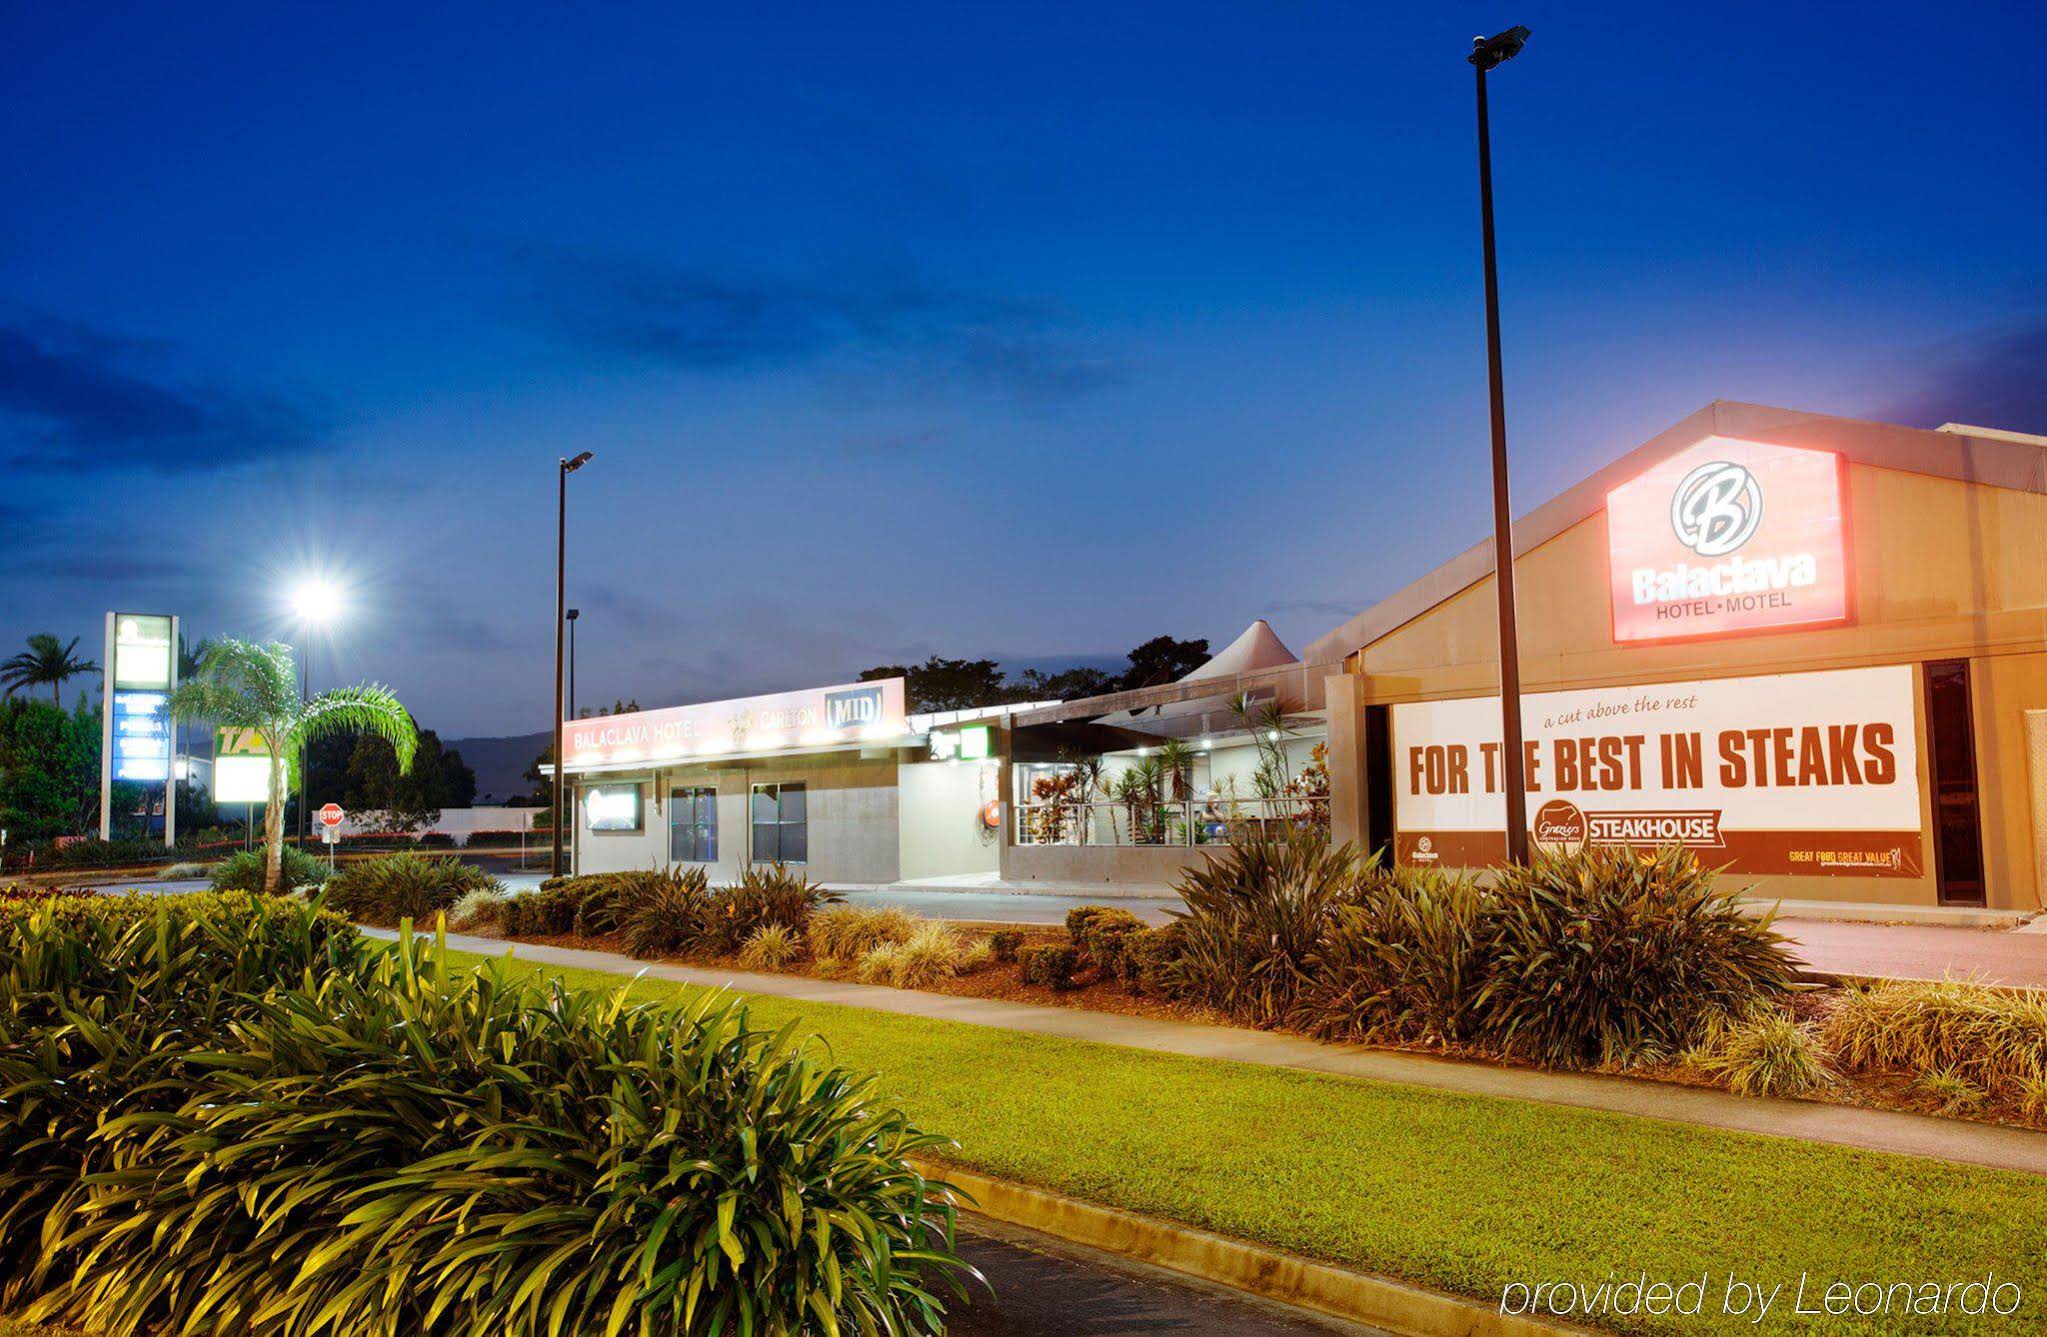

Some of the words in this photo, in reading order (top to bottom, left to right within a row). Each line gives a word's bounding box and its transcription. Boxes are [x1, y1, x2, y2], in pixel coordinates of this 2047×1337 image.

[1632, 553, 1816, 605] Balaclava
[834, 697, 874, 724] MID
[1544, 717, 1554, 728] a
[1558, 708, 1581, 725] cut
[1587, 702, 1631, 720] above
[1634, 696, 1661, 713] the
[1666, 695, 1699, 710] rest
[573, 724, 649, 750] BALACLAVA
[654, 719, 703, 739] HOTEL
[1409, 744, 1469, 795] FOR
[1554, 735, 1645, 791] BEST
[1660, 732, 1703, 789] IN
[1718, 722, 1896, 788] STEAKS
[321, 810, 344, 820] STOP
[1590, 818, 1715, 838] STEAKHOUSE
[1789, 851, 1814, 862] GREAT
[1816, 851, 1835, 862] FOOD
[1837, 852, 1862, 863] GREAT
[1865, 852, 1891, 864] VALUE
